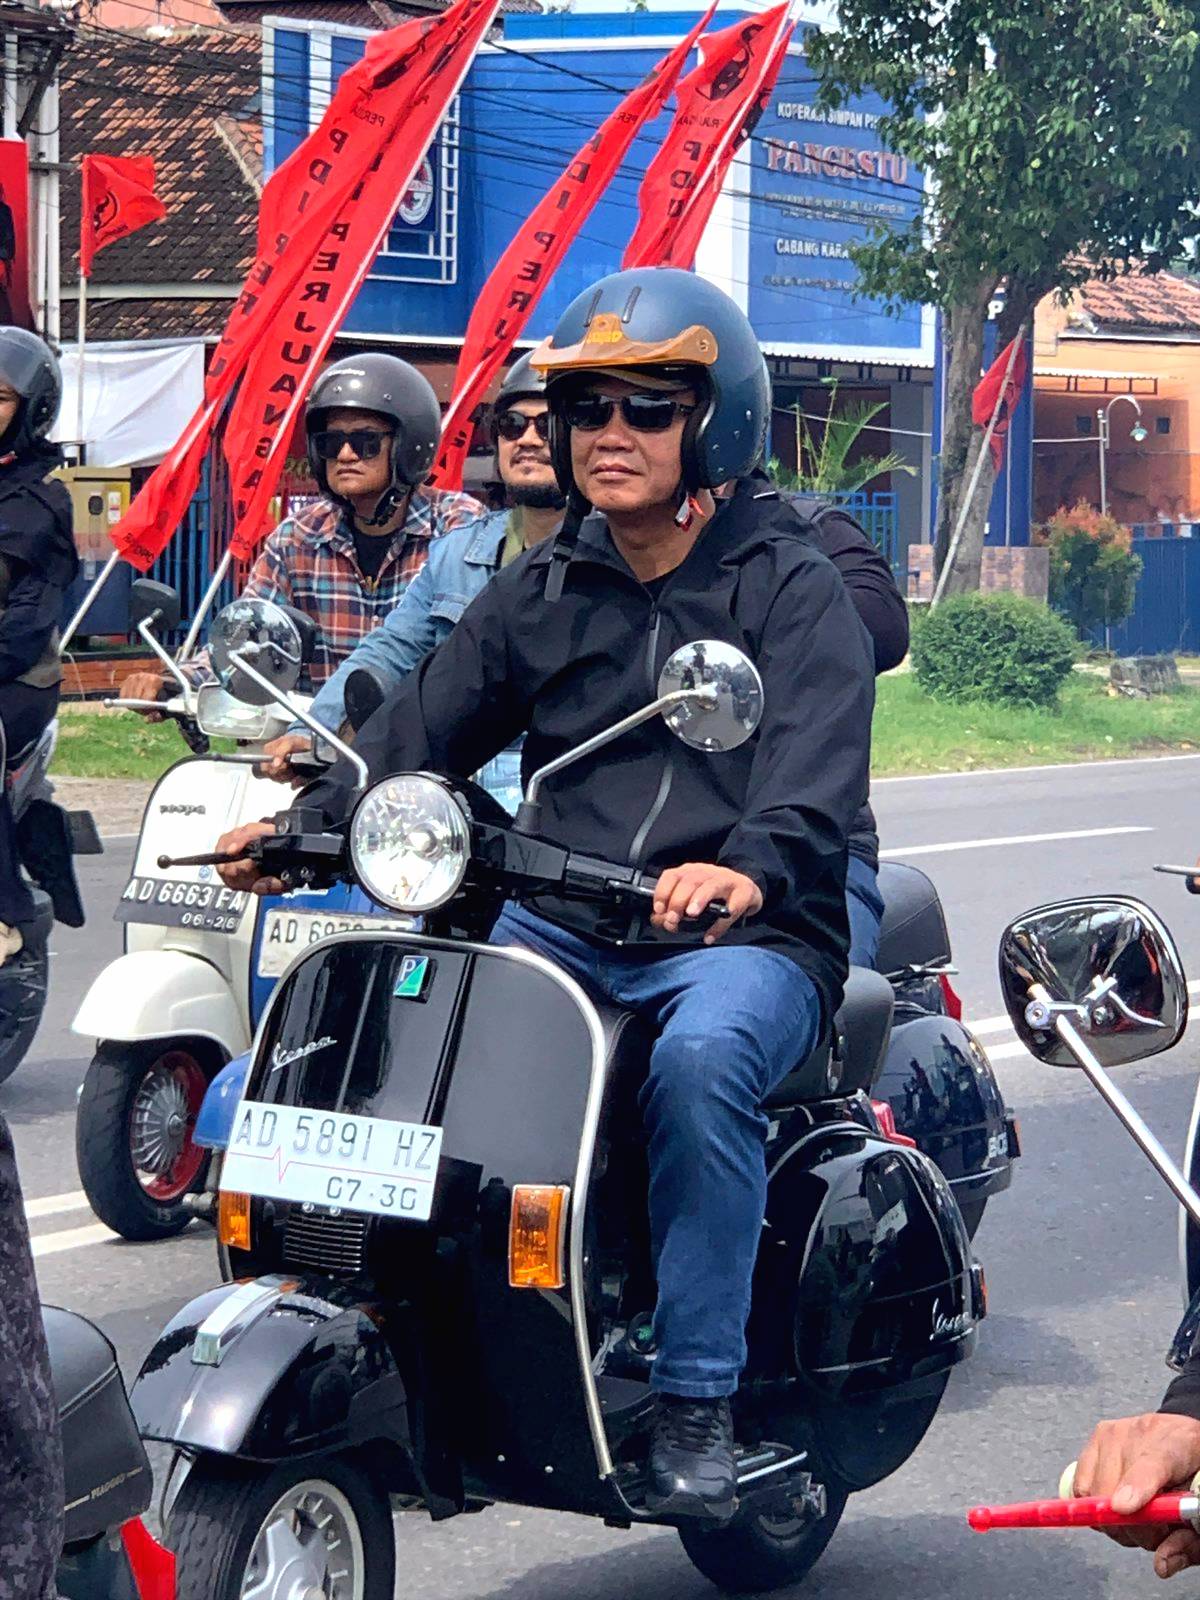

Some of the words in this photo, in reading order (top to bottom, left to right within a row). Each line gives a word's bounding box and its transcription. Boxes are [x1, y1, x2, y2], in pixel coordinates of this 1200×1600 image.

[776, 238, 819, 257] CABANG
[122, 878, 155, 901] AD
[158, 881, 213, 907] 6663
[215, 887, 243, 911] FA
[269, 918, 298, 943] AD
[272, 1036, 338, 1072] Vespa
[235, 1108, 278, 1148] AD
[292, 1114, 373, 1161] 5891
[393, 1129, 436, 1170] HZ
